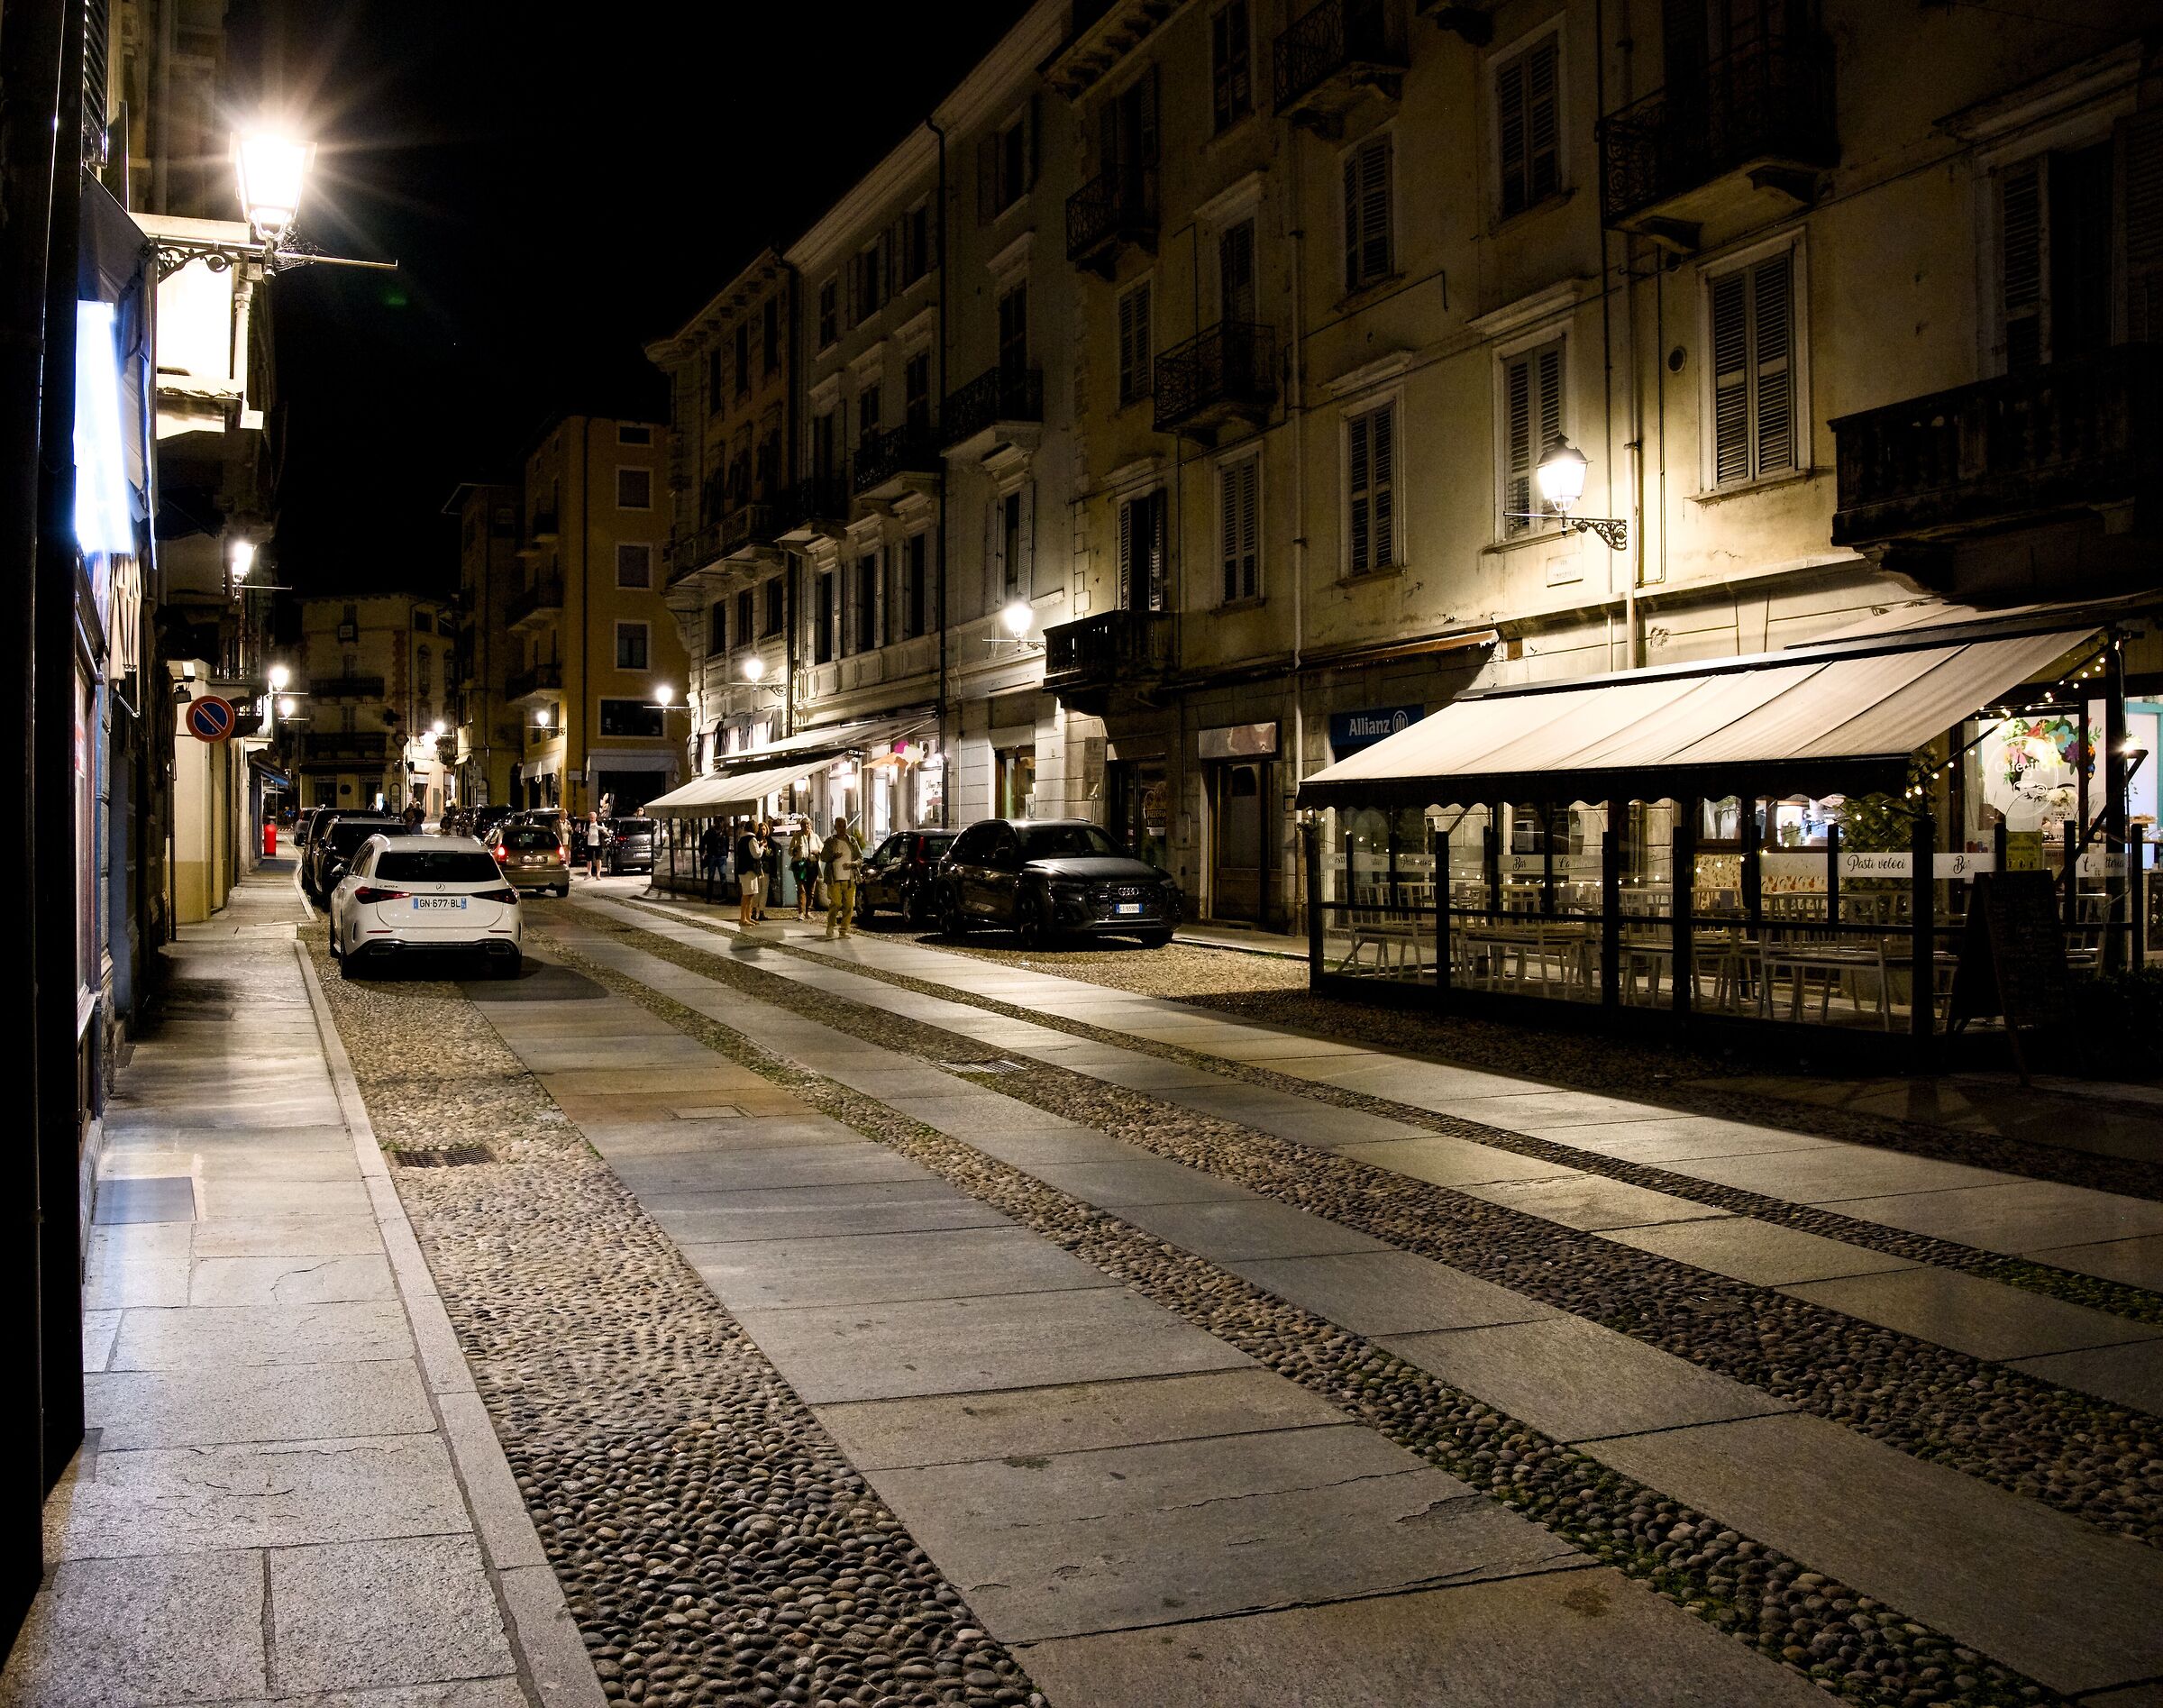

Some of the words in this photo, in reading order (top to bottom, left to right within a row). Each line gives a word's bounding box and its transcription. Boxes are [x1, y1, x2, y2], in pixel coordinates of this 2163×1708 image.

[1349, 717, 1391, 736] Allianz
[1513, 856, 1527, 871] Bar
[1848, 854, 1875, 872] Pasti
[1878, 857, 1905, 869] veloci
